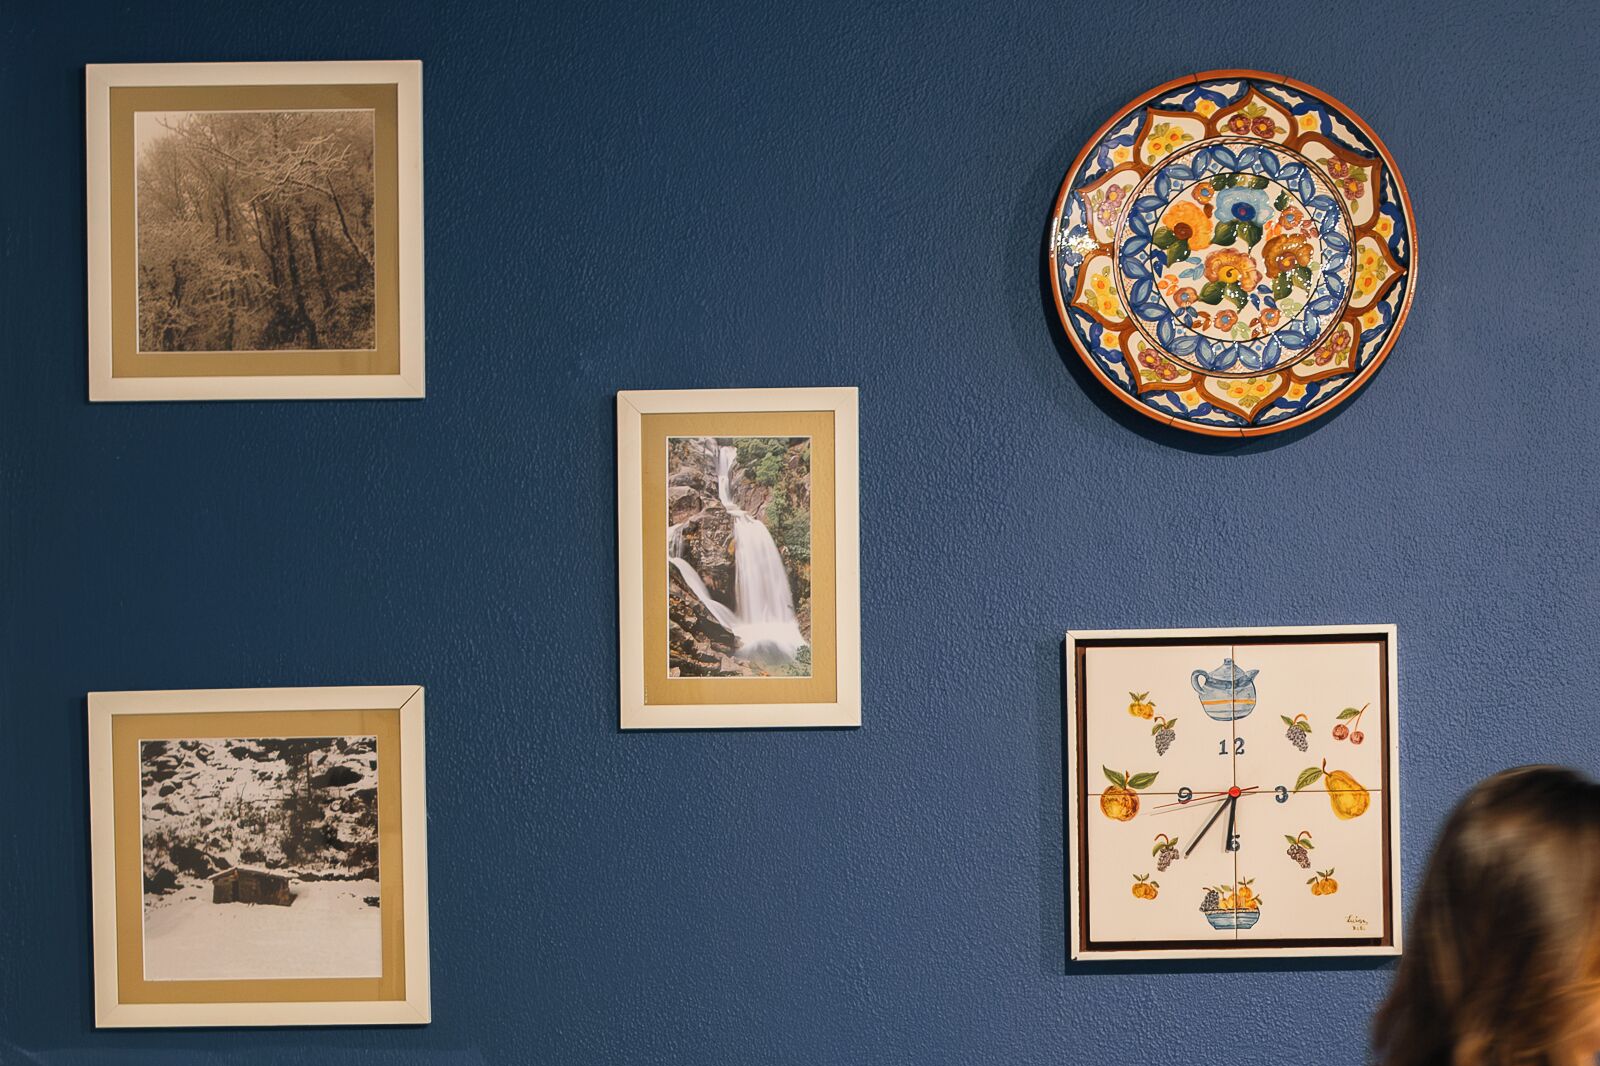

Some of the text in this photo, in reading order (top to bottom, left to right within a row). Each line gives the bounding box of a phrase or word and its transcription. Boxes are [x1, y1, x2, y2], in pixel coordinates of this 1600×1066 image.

[1218, 737, 1246, 756] 12
[1177, 786, 1193, 805] 9
[1274, 785, 1289, 804] 3
